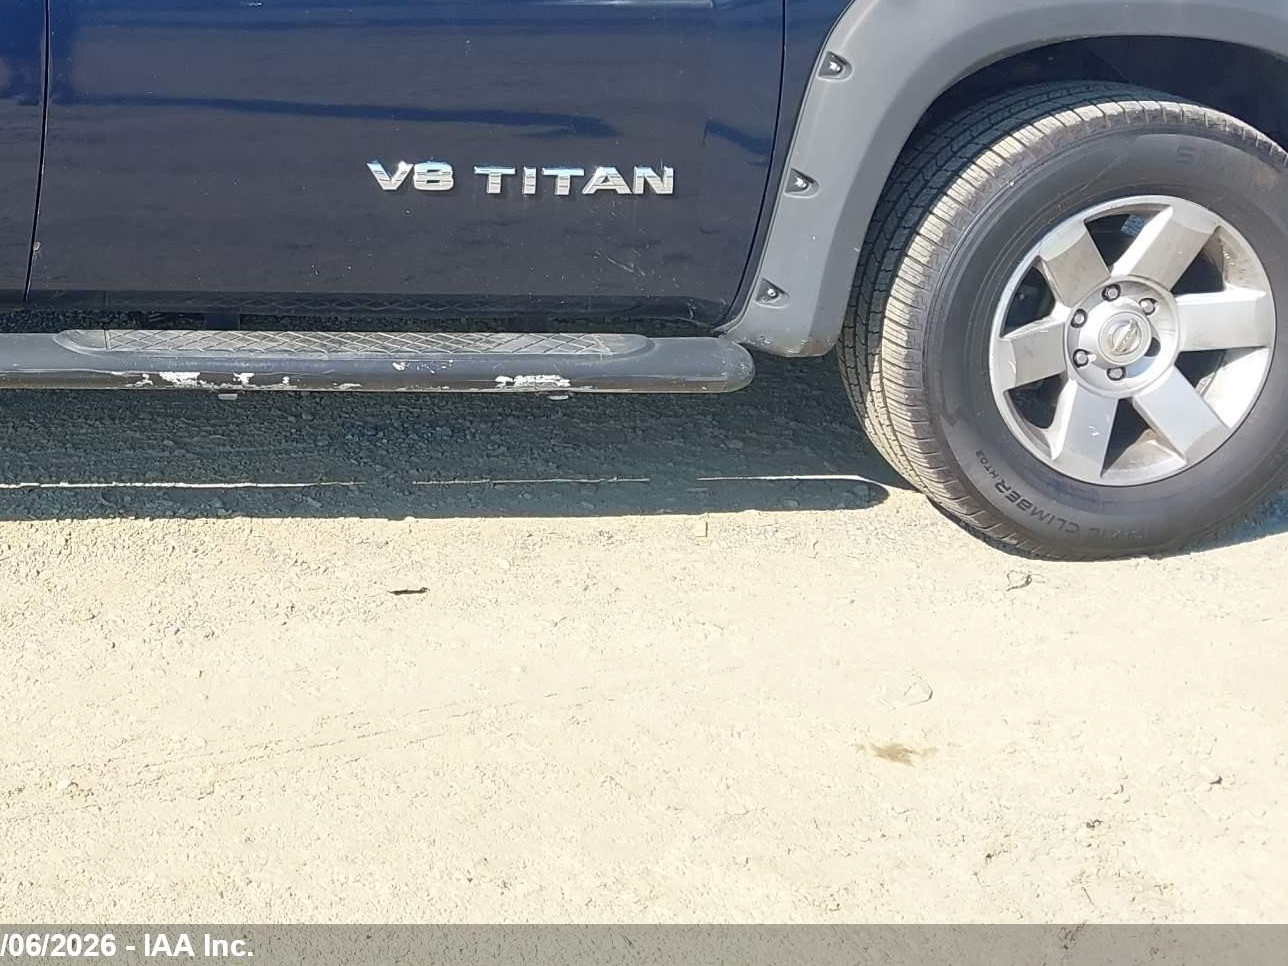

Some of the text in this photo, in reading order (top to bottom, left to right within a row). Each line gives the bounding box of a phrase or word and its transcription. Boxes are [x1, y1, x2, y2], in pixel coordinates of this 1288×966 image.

[367, 162, 675, 195] V8 TITAN
[994, 478, 1081, 534] CLIMBER
